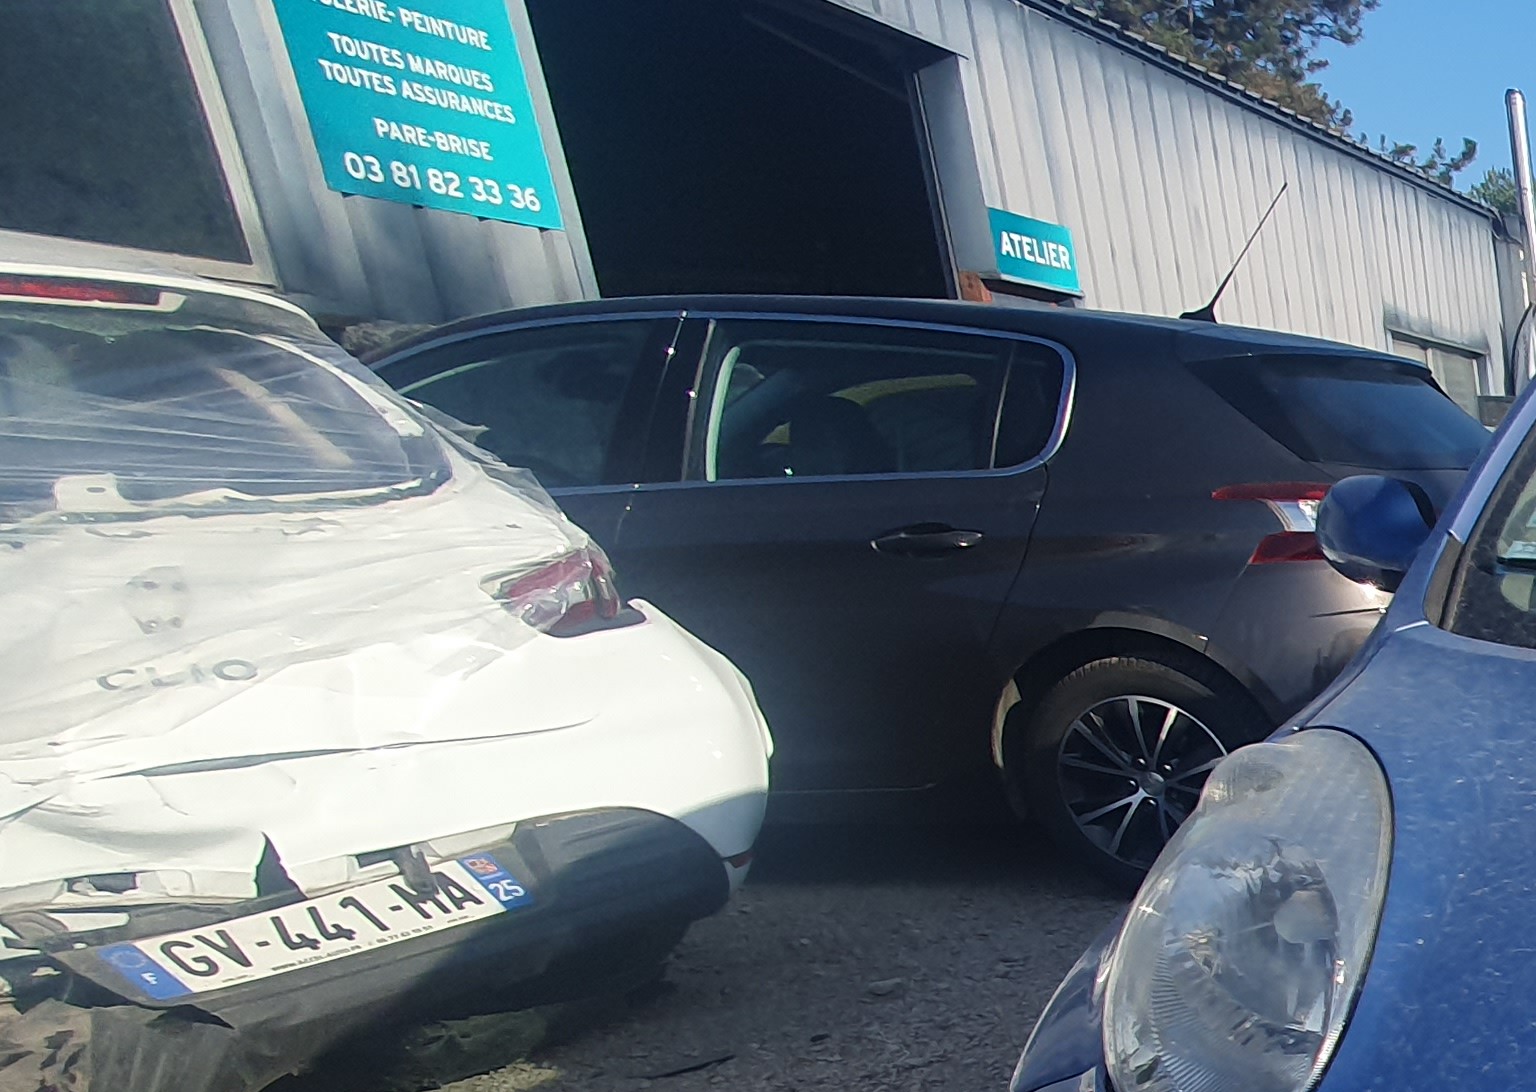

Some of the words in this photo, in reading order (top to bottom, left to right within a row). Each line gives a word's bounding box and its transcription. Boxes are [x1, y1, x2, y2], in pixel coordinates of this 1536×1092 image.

[313, 0, 396, 23] LERIE-
[398, 7, 492, 51] PEINTURE
[327, 32, 405, 70] TOUTES
[406, 53, 494, 92] MARQUES
[317, 59, 397, 96] TOUTES
[402, 79, 516, 124] ASSURANCES
[373, 117, 494, 161] PARE-BRISE
[344, 152, 385, 183] 03
[390, 160, 422, 190] 81
[427, 168, 464, 198] 82
[469, 177, 503, 205] 33
[507, 184, 542, 212] 36
[1001, 231, 1072, 270] ATELIER
[488, 879, 525, 902] 25
